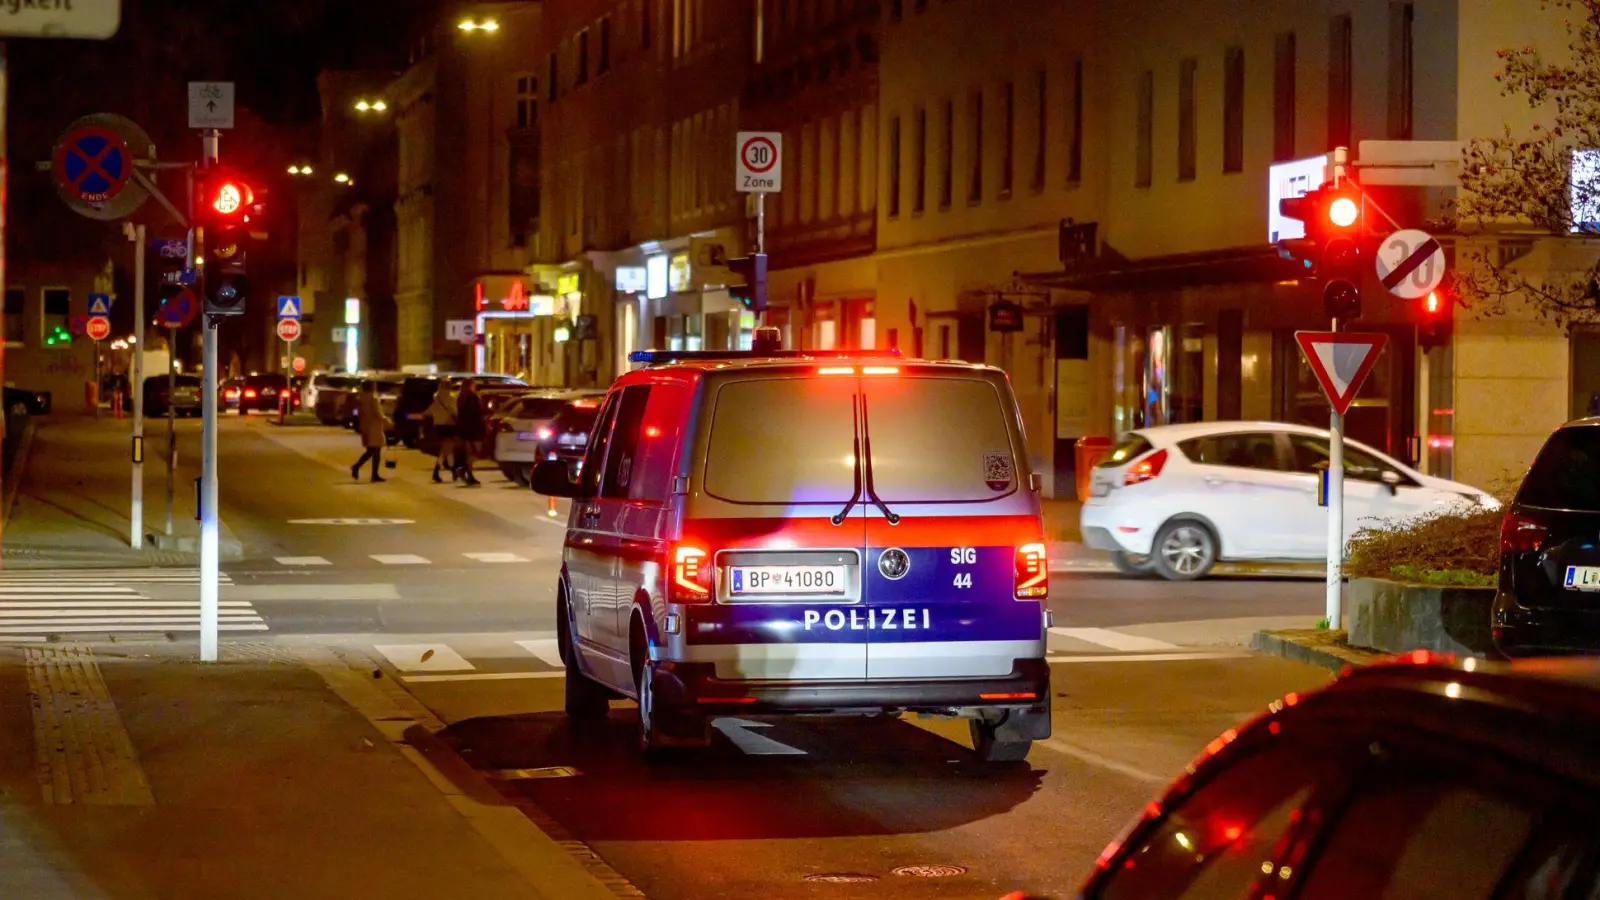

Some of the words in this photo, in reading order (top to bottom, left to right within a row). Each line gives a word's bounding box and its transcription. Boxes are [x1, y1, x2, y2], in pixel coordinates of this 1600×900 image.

[751, 146, 768, 164] 30
[744, 176, 774, 188] Zone
[81, 192, 109, 201] ENDE
[279, 324, 299, 334] STOP
[951, 547, 977, 564] SIG
[750, 571, 770, 588] BP
[784, 570, 834, 587] 41080
[953, 573, 973, 589] 44
[1582, 569, 1589, 585] L
[804, 608, 930, 631] POLIZEI
